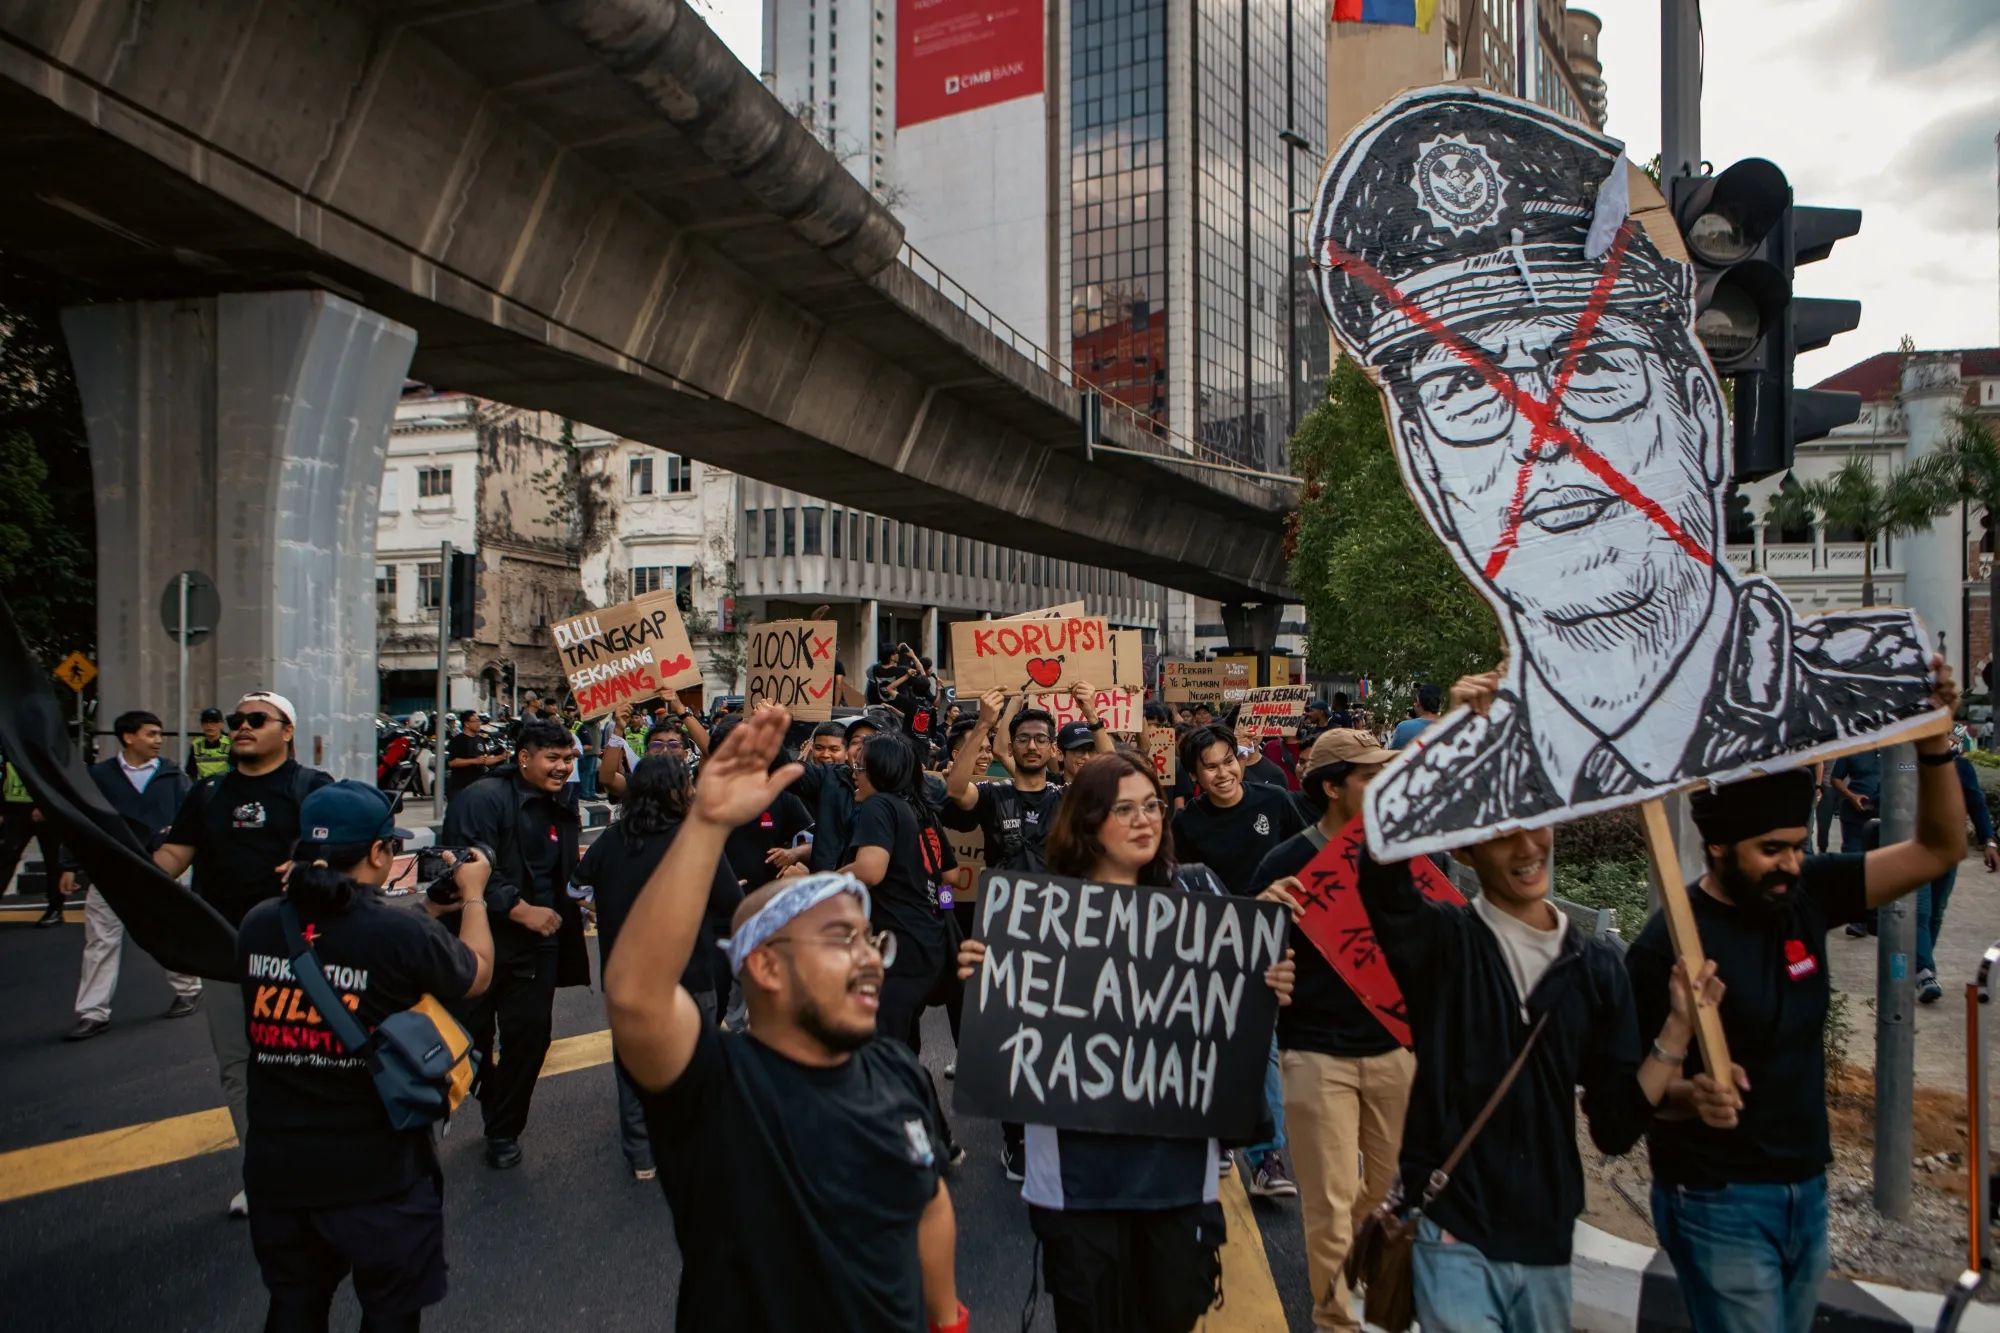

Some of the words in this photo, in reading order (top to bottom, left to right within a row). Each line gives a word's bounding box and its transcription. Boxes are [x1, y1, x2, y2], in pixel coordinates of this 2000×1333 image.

[961, 69, 991, 88] CIMB
[992, 61, 1024, 81] BANK
[553, 616, 602, 649] DULU
[563, 610, 667, 667] TANGKAP
[752, 626, 814, 670] 100K
[973, 617, 1105, 658] KORUPSI
[568, 647, 654, 691] SEKARANG
[1167, 663, 1175, 676] 3
[1178, 663, 1213, 675] PERKARA
[577, 667, 656, 715] SAYANG
[750, 675, 811, 710] 800K
[1190, 690, 1220, 701] NEGARA
[1251, 703, 1292, 715] MANUSIA
[1272, 688, 1309, 701] SEBAGAI
[1237, 715, 1262, 727] MATI
[982, 875, 1286, 972] PEREMPUAN
[248, 953, 369, 992] INFORTION
[253, 984, 360, 1025] KILL
[979, 945, 1246, 1041] MELAWAN
[999, 1023, 1218, 1117] RASUAH
